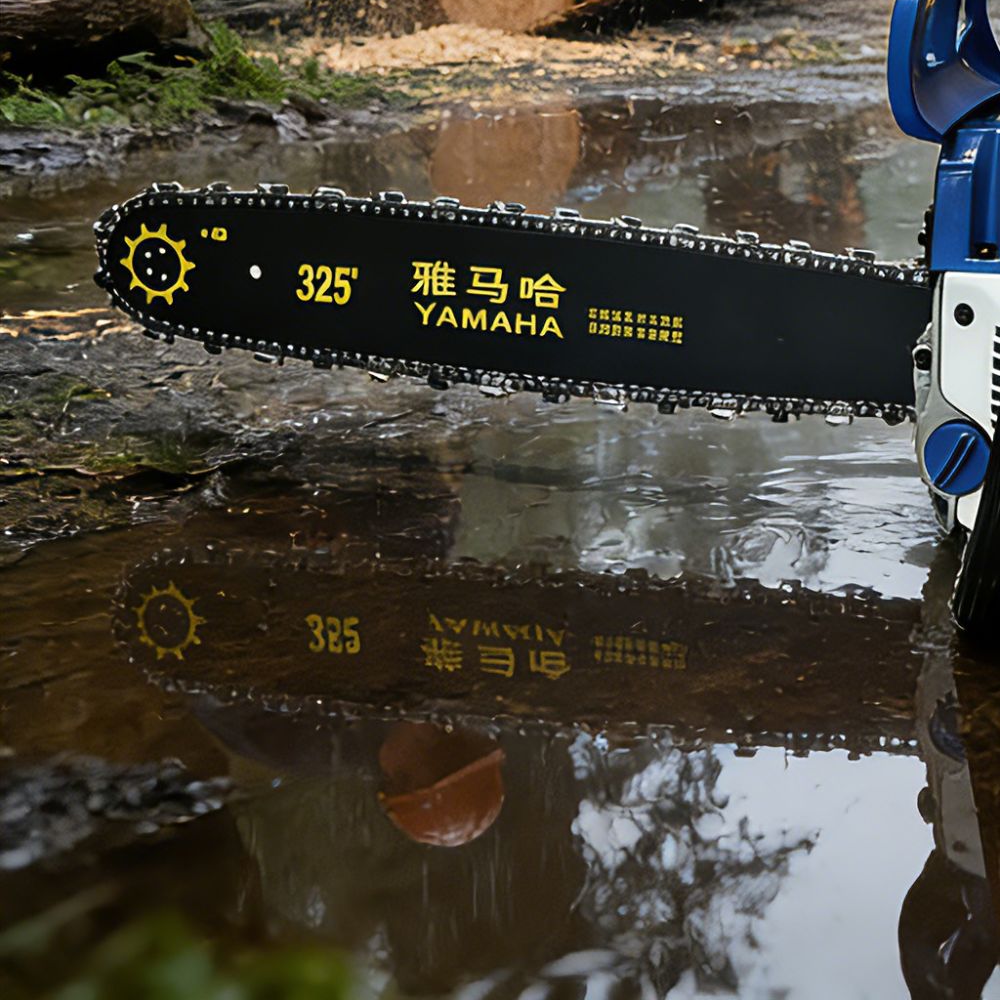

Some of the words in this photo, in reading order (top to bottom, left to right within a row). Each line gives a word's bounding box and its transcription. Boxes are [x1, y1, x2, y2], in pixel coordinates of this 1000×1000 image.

[410, 260, 568, 309] 雅马哈
[413, 300, 565, 340] YAMAHA
